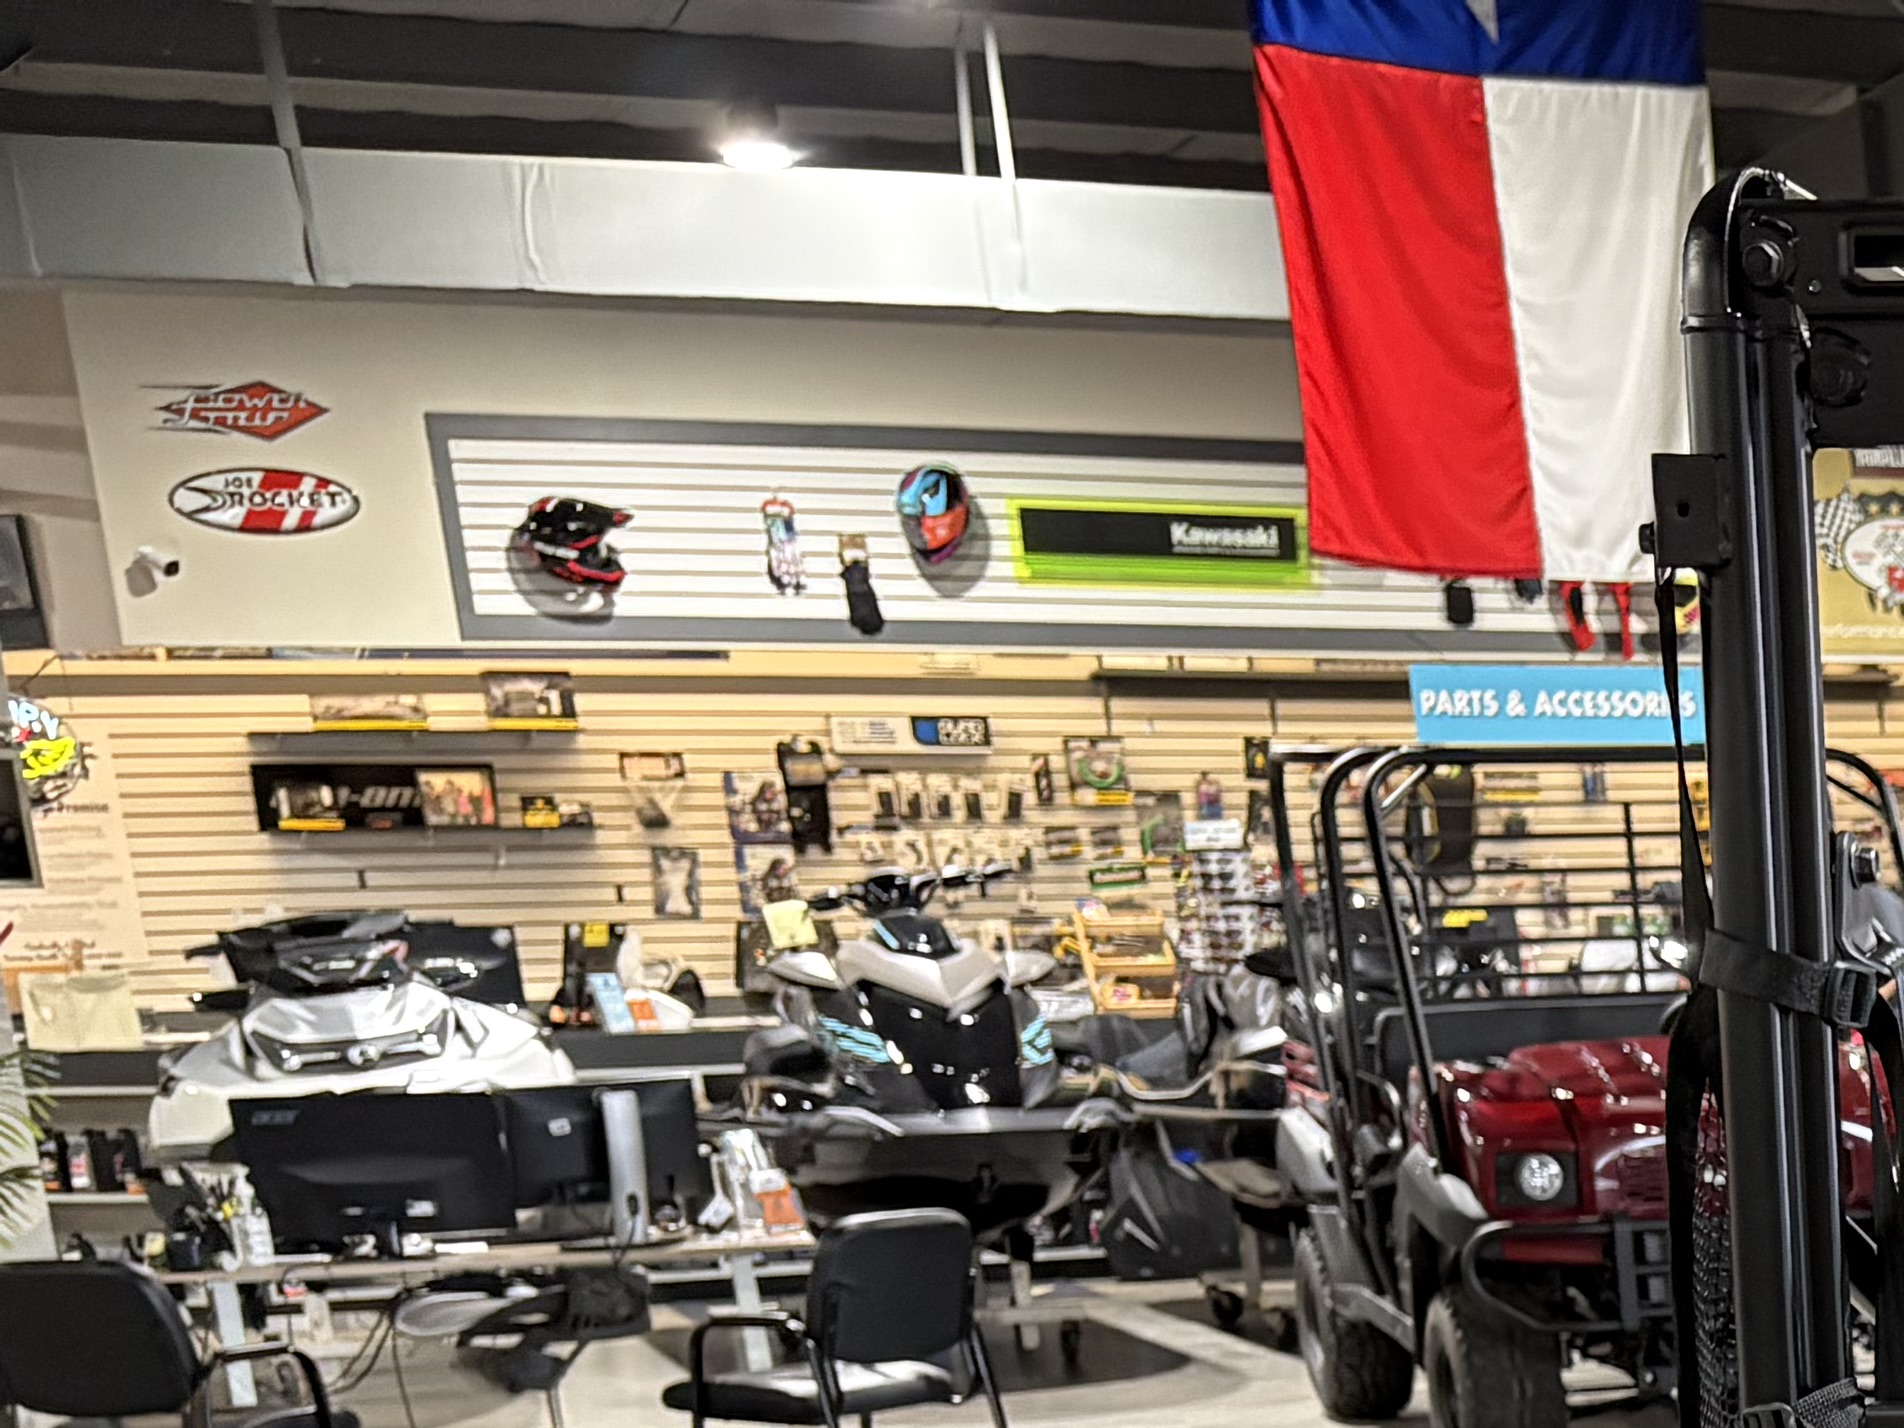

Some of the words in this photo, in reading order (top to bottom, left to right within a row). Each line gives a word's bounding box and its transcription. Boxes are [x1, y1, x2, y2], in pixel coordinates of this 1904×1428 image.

[1170, 521, 1279, 547] Kawasaki
[1419, 689, 1499, 716] PARTS
[1506, 689, 1526, 716] &
[1534, 689, 1696, 717] ACCESSORIS
